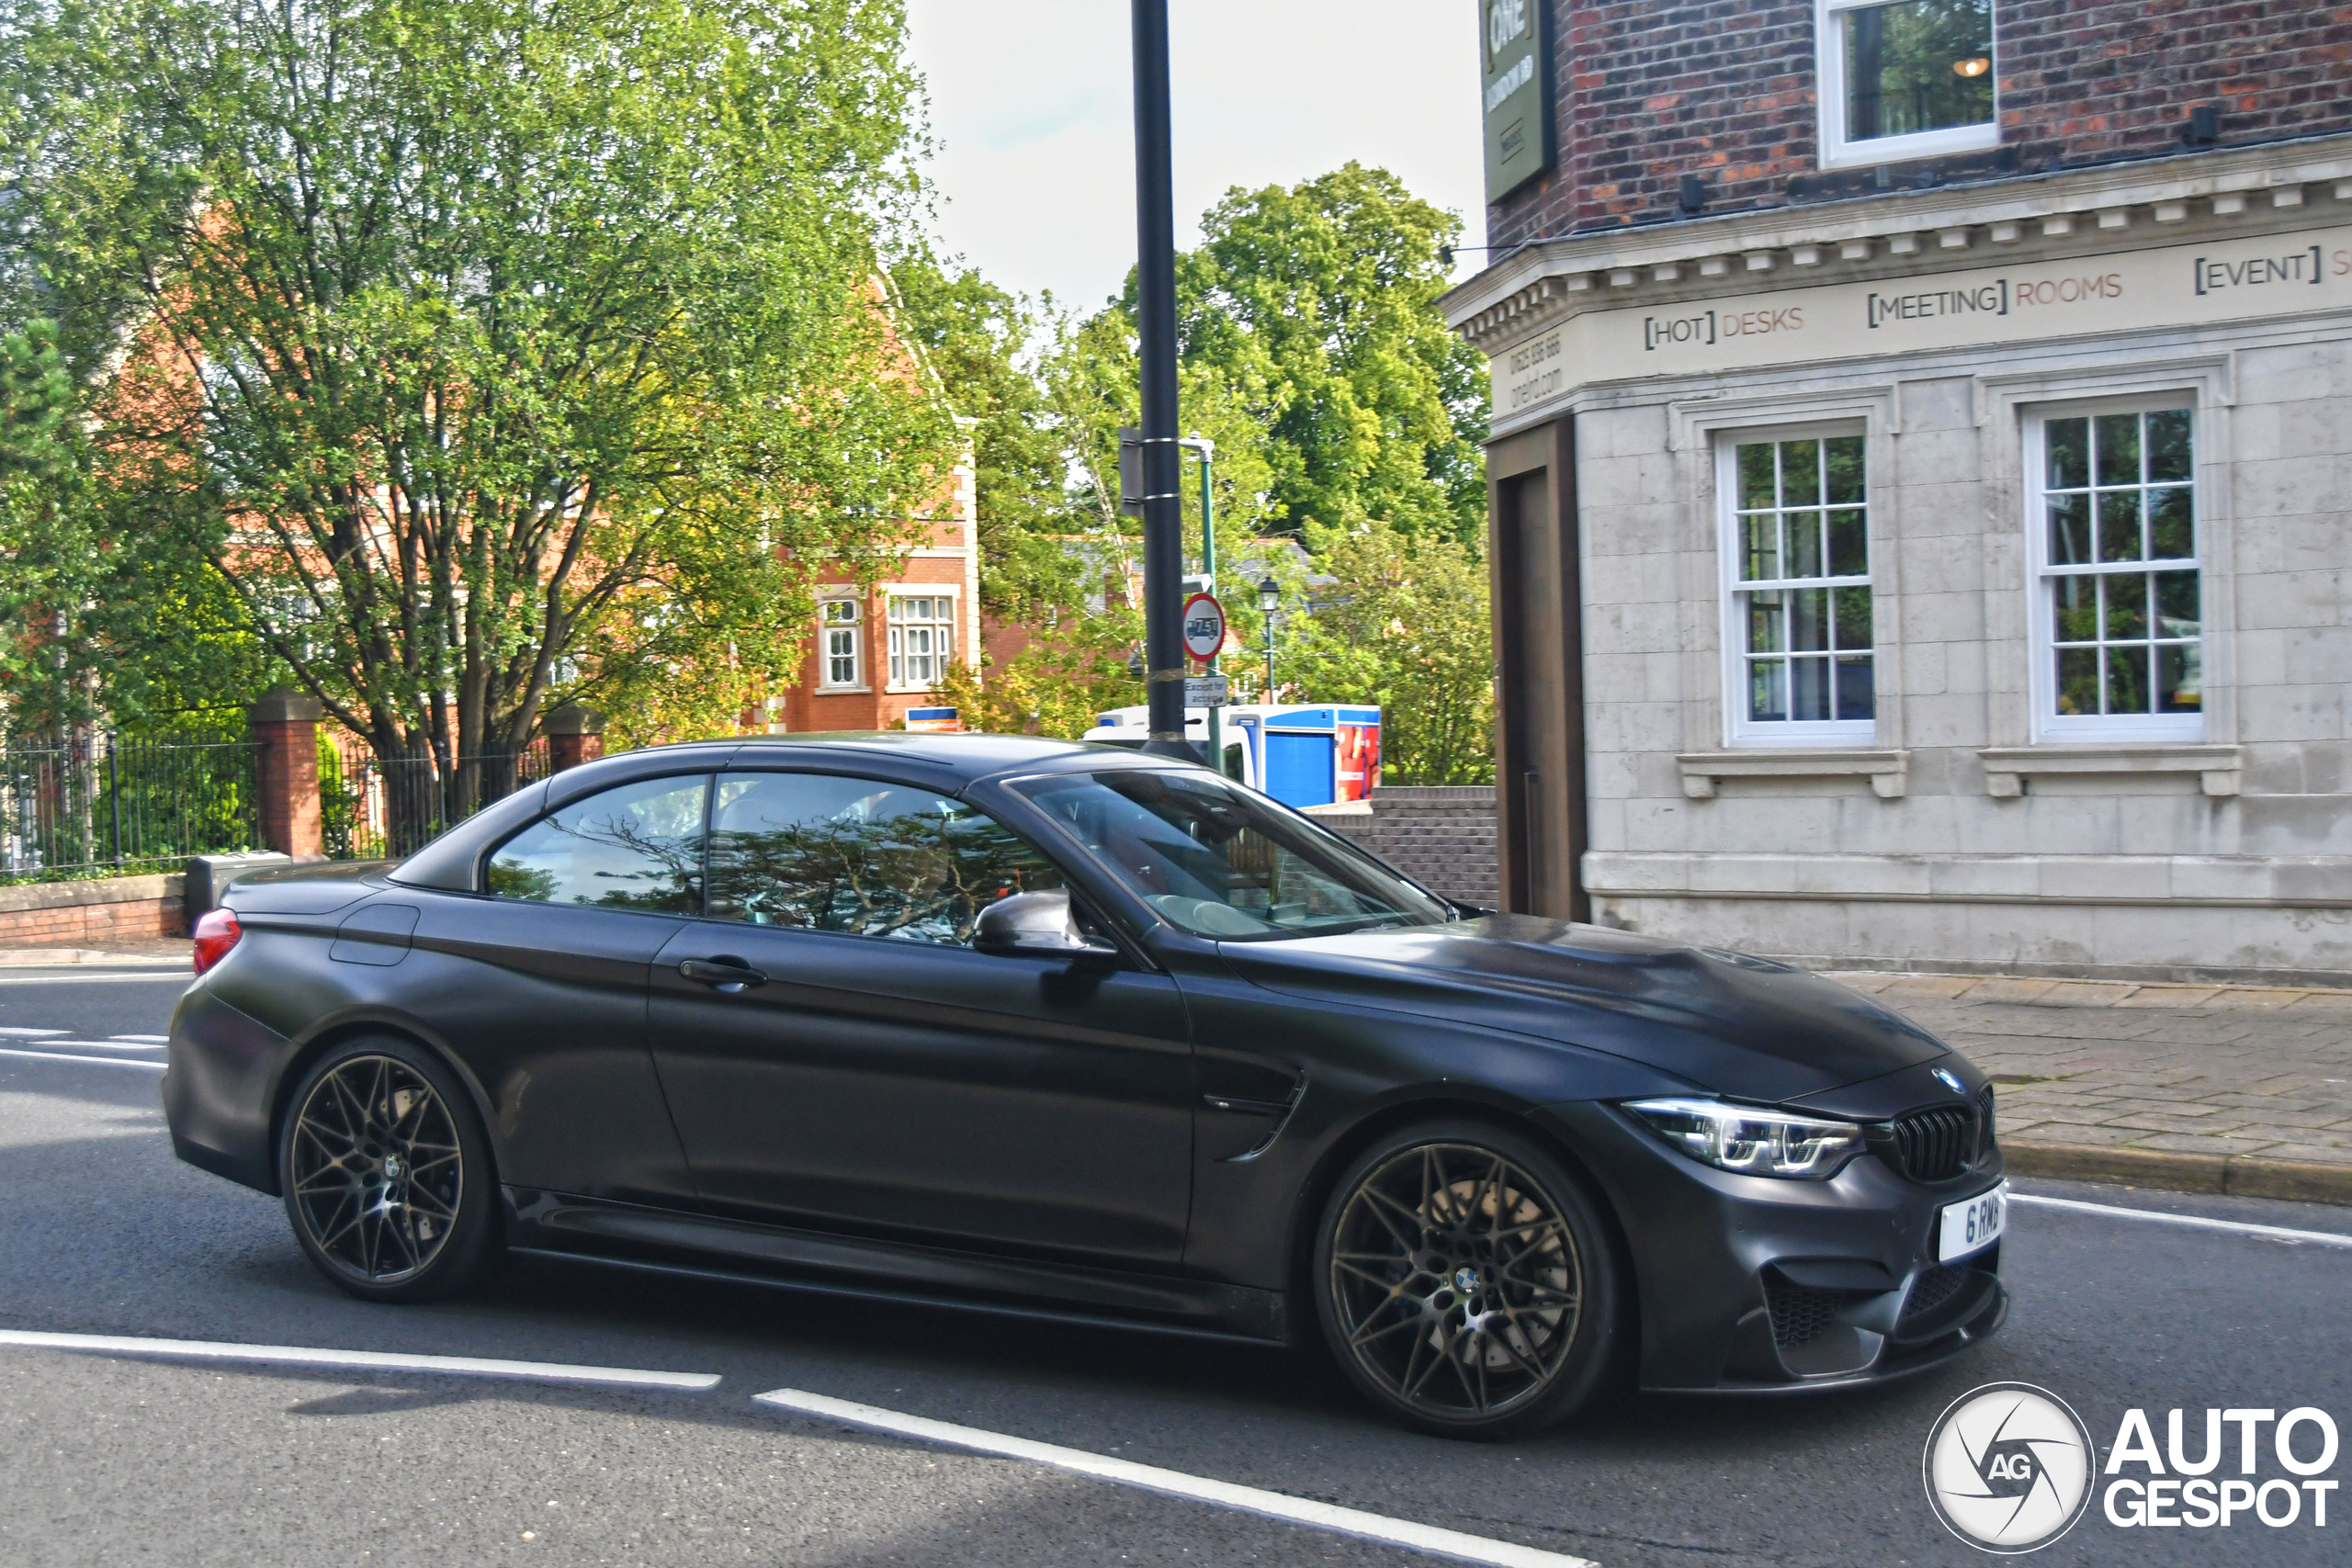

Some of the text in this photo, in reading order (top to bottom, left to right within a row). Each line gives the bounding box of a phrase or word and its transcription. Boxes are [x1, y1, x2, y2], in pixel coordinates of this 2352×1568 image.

[2195, 245, 2321, 296] [EVENT]
[1868, 274, 2122, 329] [MEETING] ROOMS
[1645, 307, 1804, 351] [HOT] DESKS
[1966, 1194, 1999, 1244] 6 RMB
